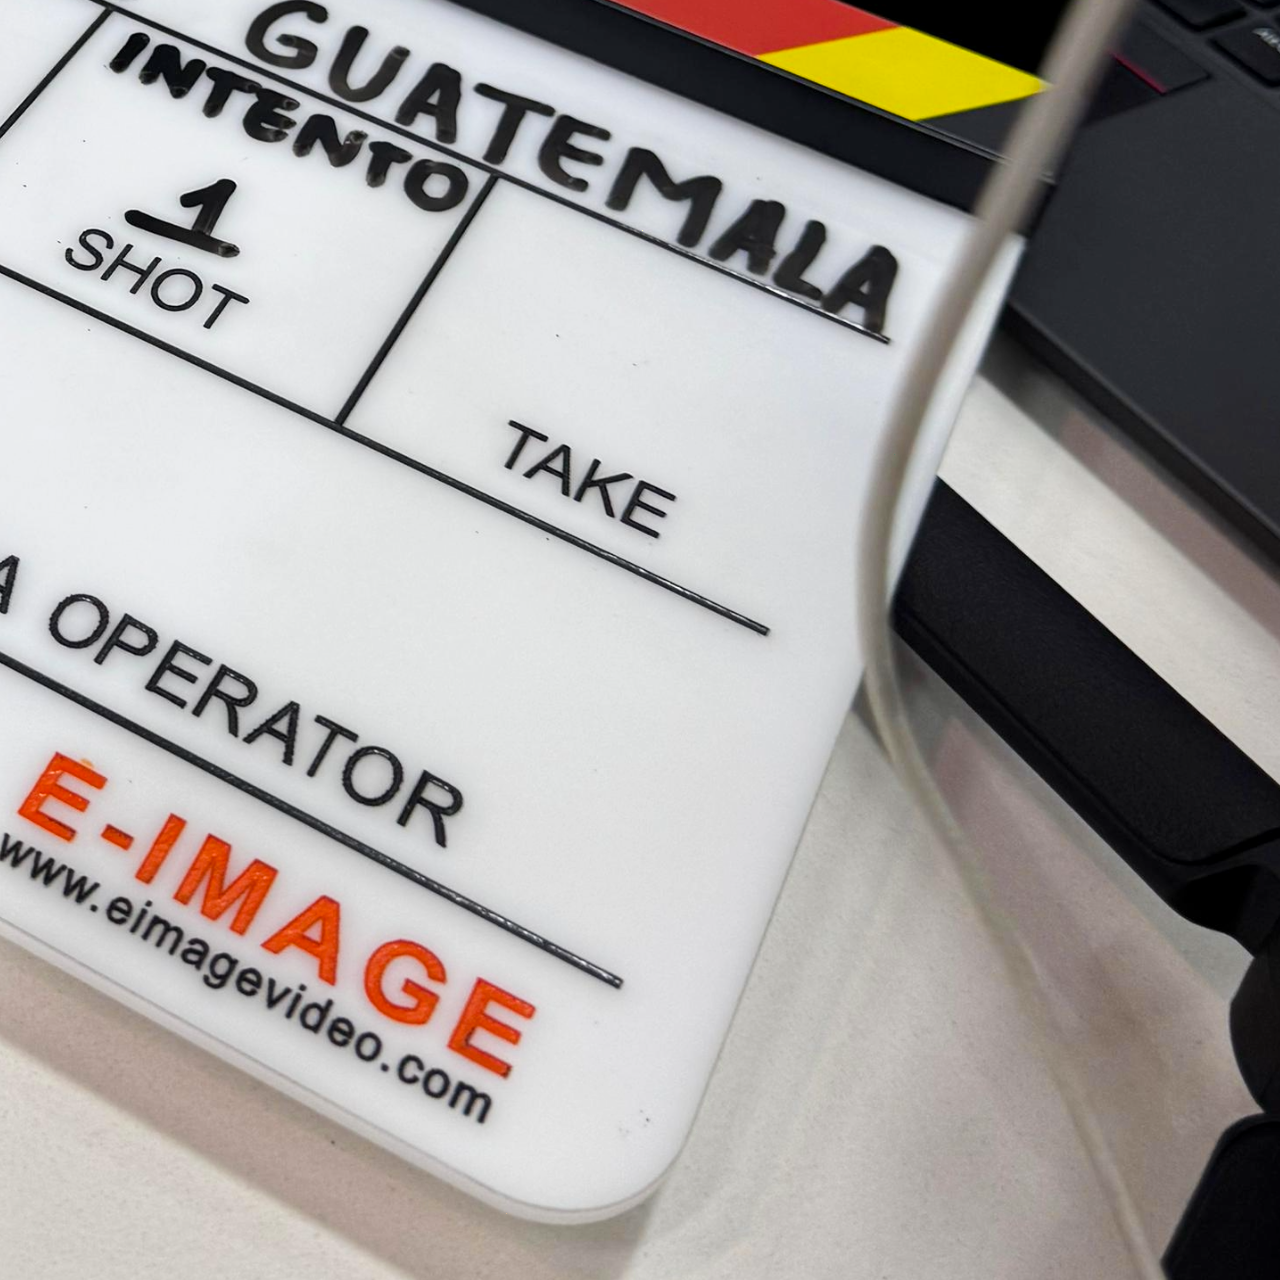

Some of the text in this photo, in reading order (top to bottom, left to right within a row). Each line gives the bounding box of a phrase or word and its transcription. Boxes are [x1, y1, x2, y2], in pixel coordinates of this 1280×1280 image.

[109, 32, 468, 212] INTENTO
[245, 0, 898, 333] GUATEMALA
[65, 228, 250, 330] SHOT
[124, 178, 240, 258] 1
[500, 420, 677, 539] TAKE
[48, 593, 464, 848] OPERATOR
[18, 751, 536, 1079] E-IMAGE
